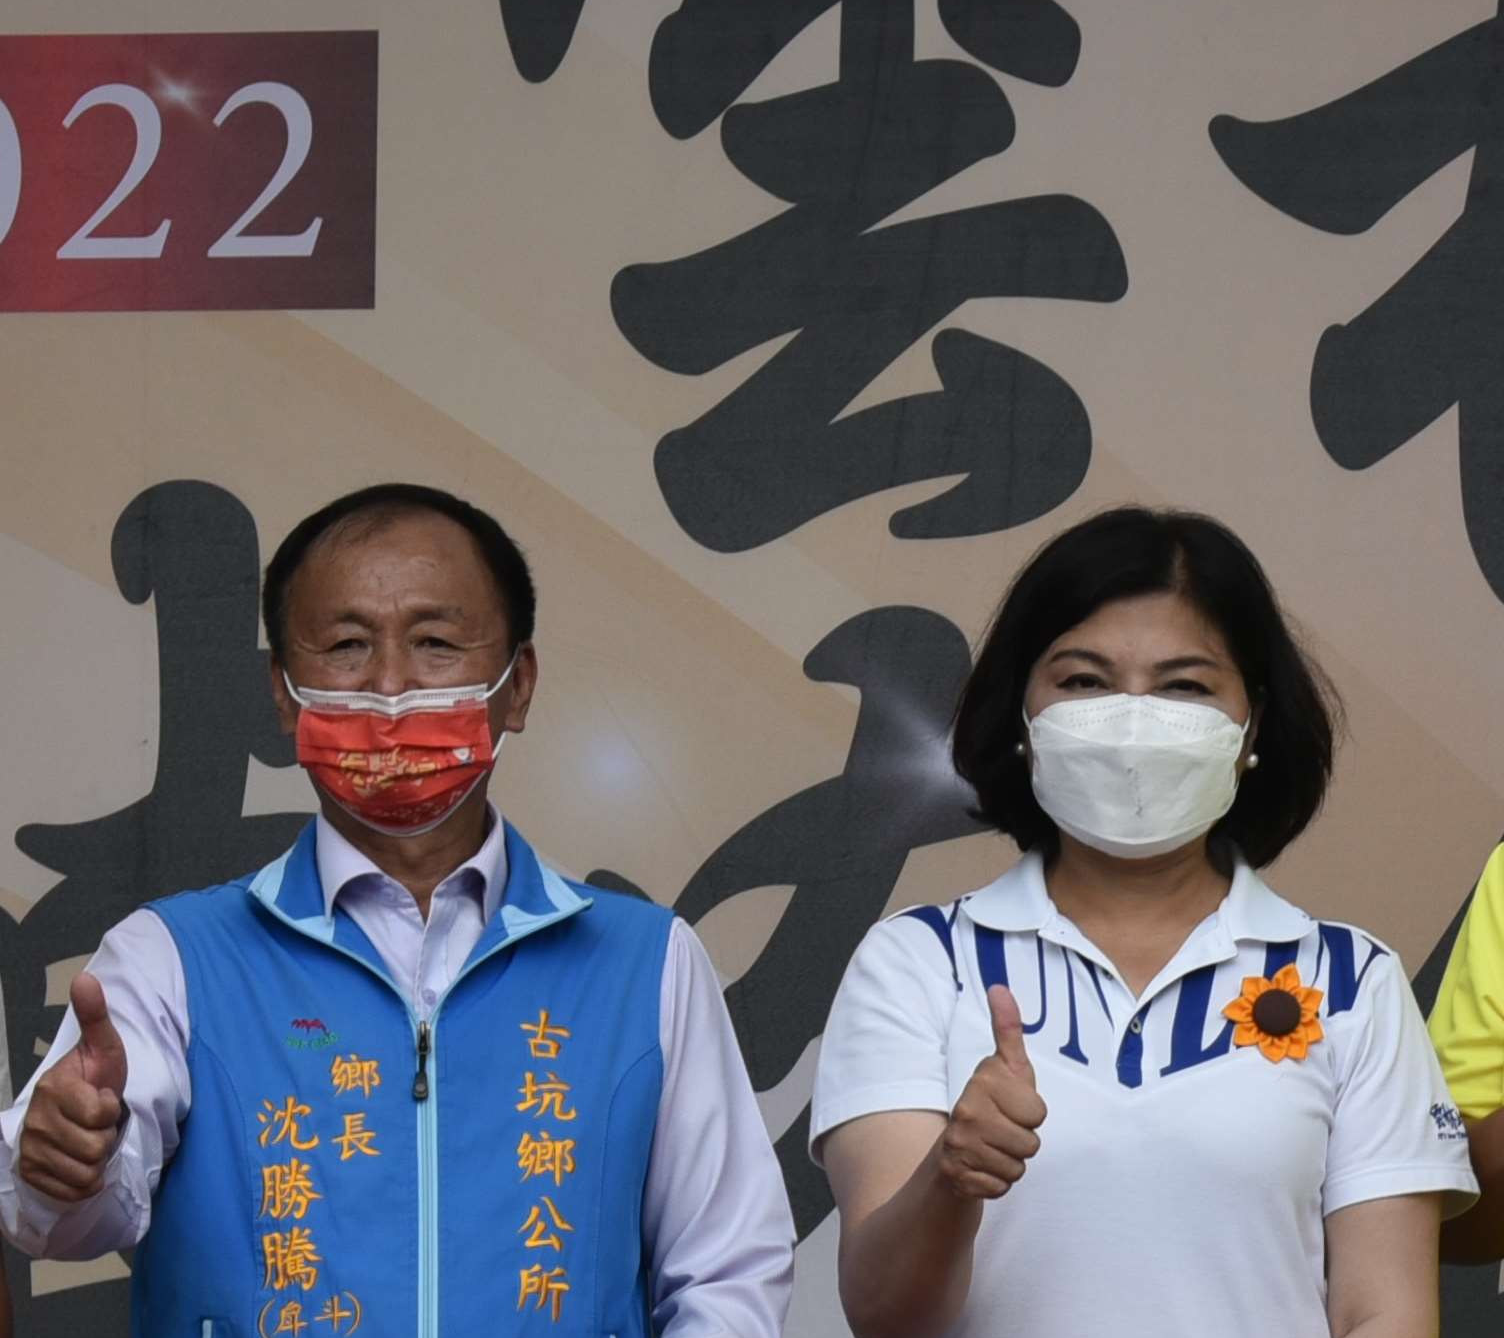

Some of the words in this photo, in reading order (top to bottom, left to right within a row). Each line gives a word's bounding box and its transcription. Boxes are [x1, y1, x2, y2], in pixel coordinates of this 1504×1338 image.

[257, 1095, 324, 1292] 沈勝騰
[330, 1053, 382, 1161] 鄉長
[516, 1009, 579, 1323] 古坑鄉公所
